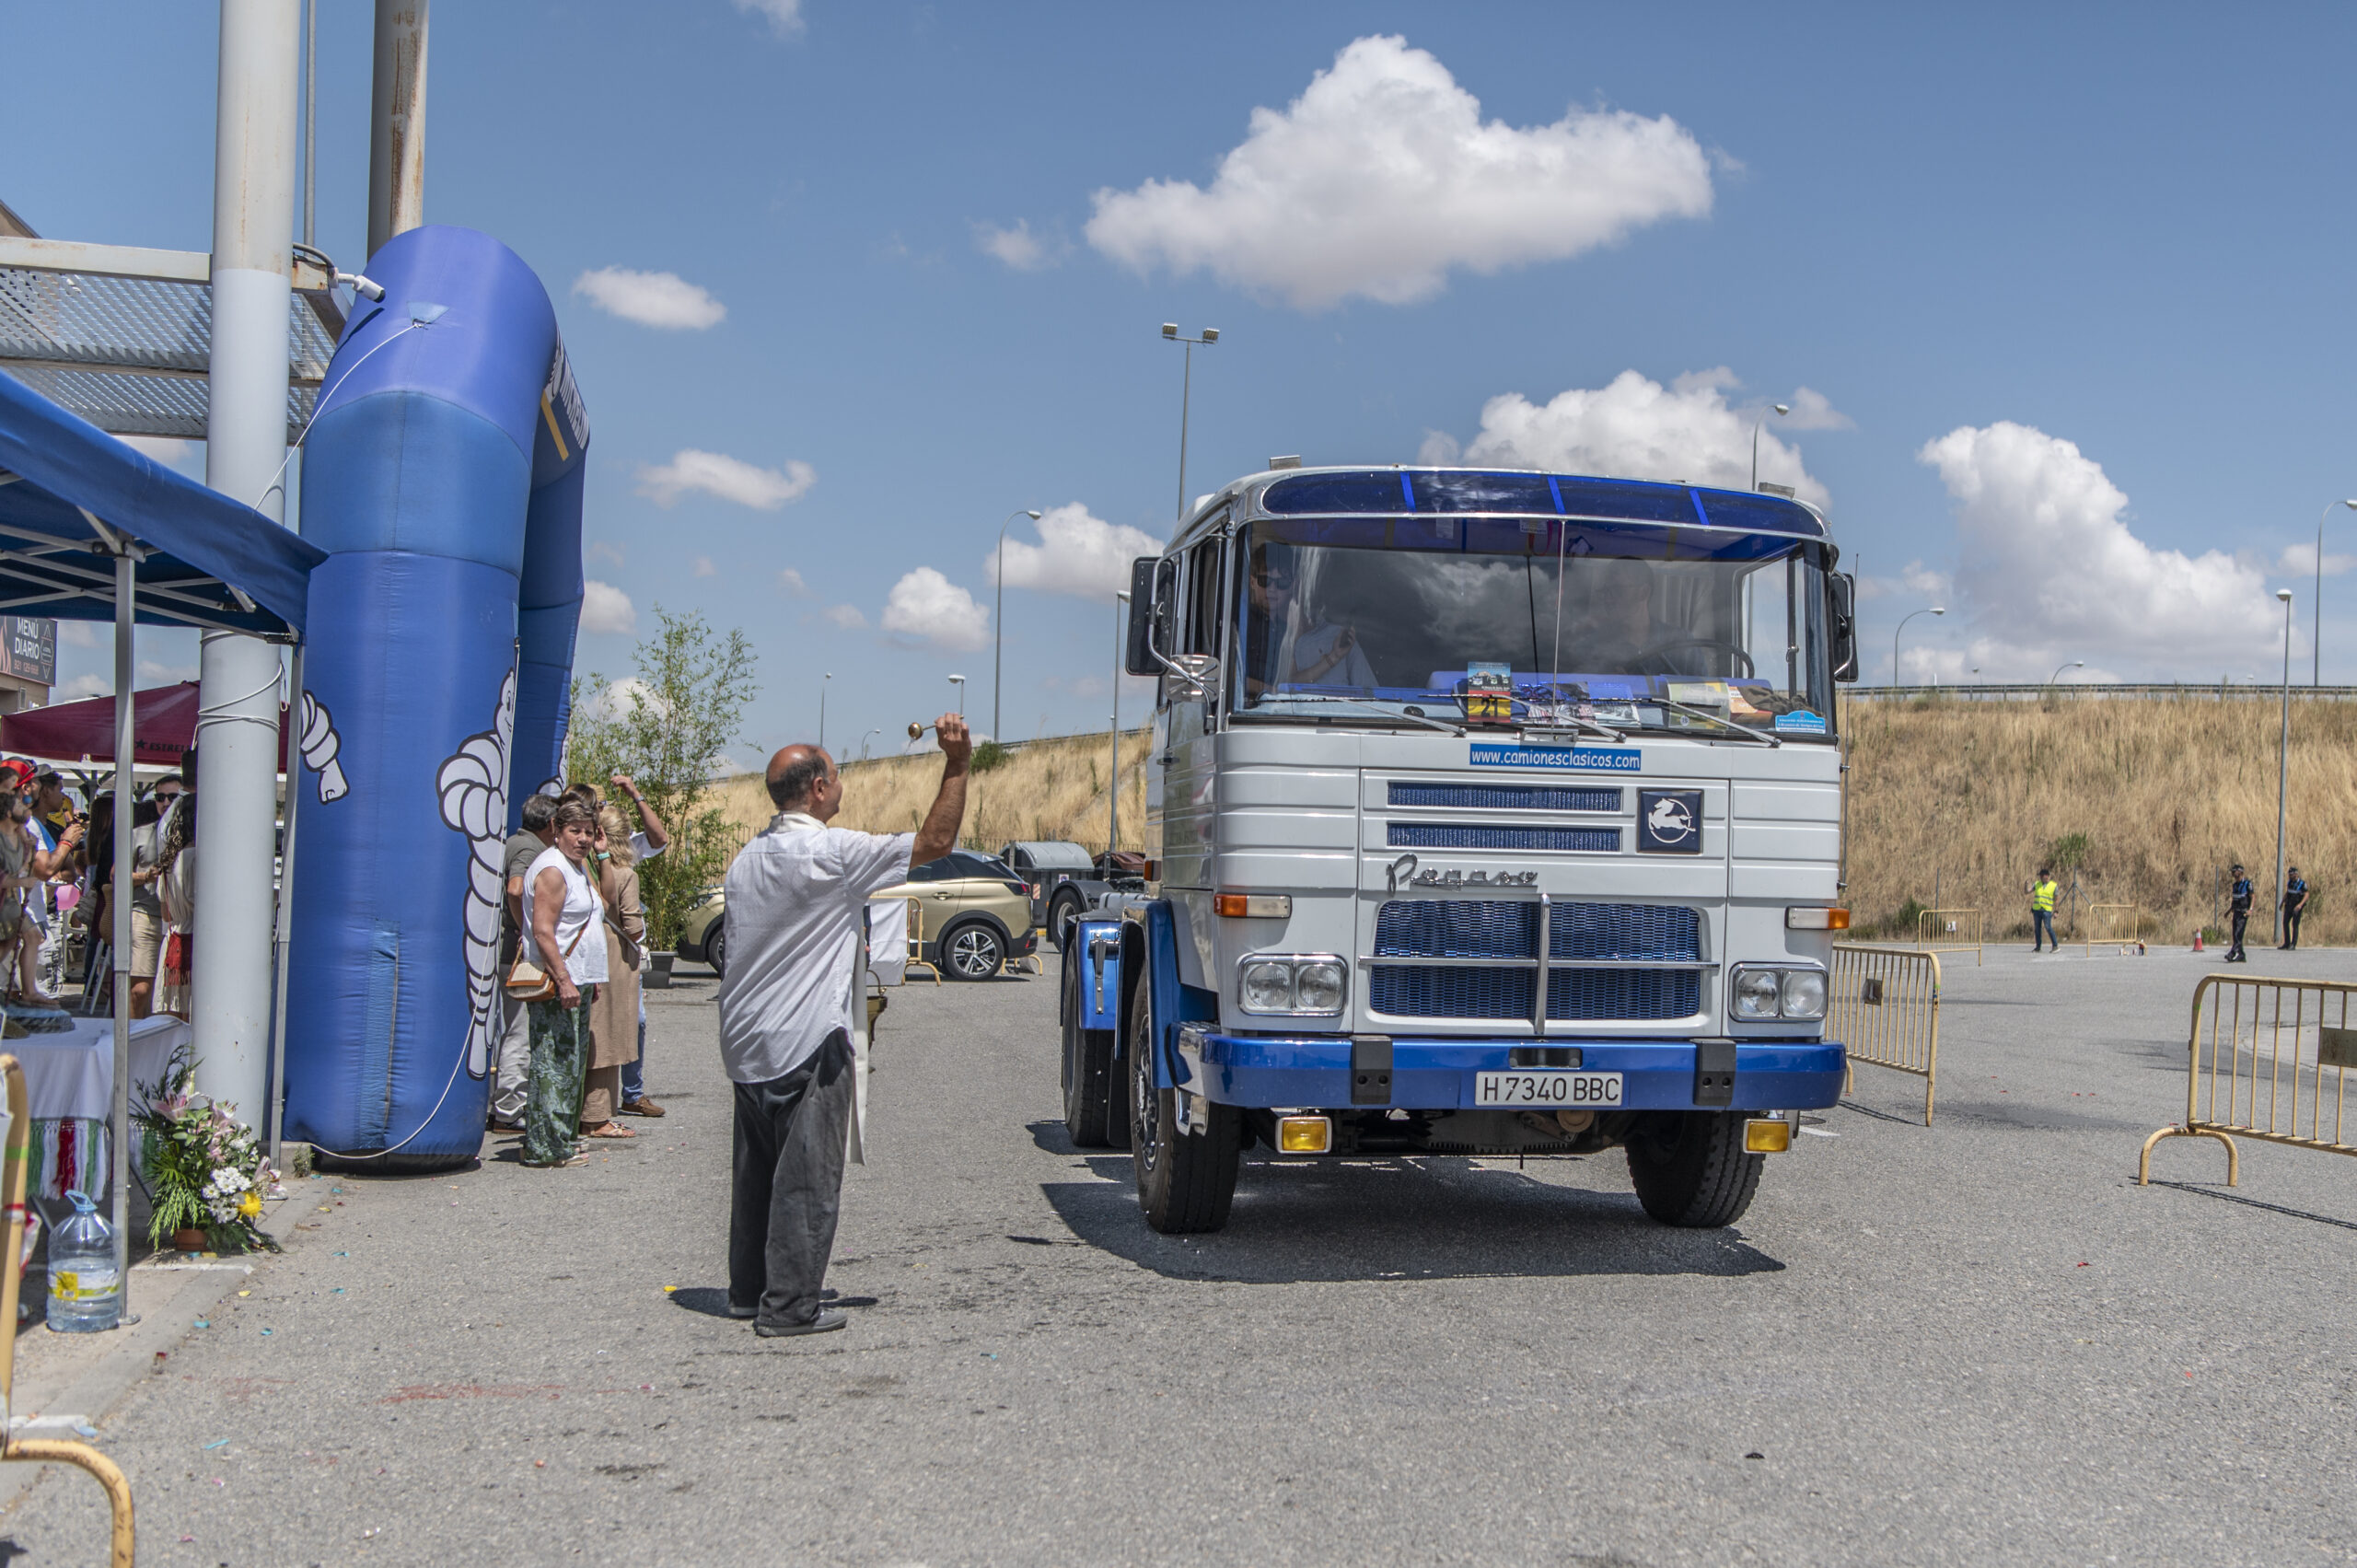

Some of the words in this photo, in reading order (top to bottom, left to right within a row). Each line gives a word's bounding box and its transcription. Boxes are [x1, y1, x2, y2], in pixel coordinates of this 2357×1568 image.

[17, 617, 39, 639] MENÚ
[15, 636, 40, 659] DIARIO
[1480, 697, 1498, 717] 21
[149, 742, 190, 752] ESTREL
[1471, 749, 1640, 769] www.camionesclasicos.com
[1386, 853, 1538, 898] Pegaso
[1483, 1076, 1499, 1101] H
[1504, 1076, 1567, 1101] 7340
[1573, 1077, 1620, 1101] BBC
